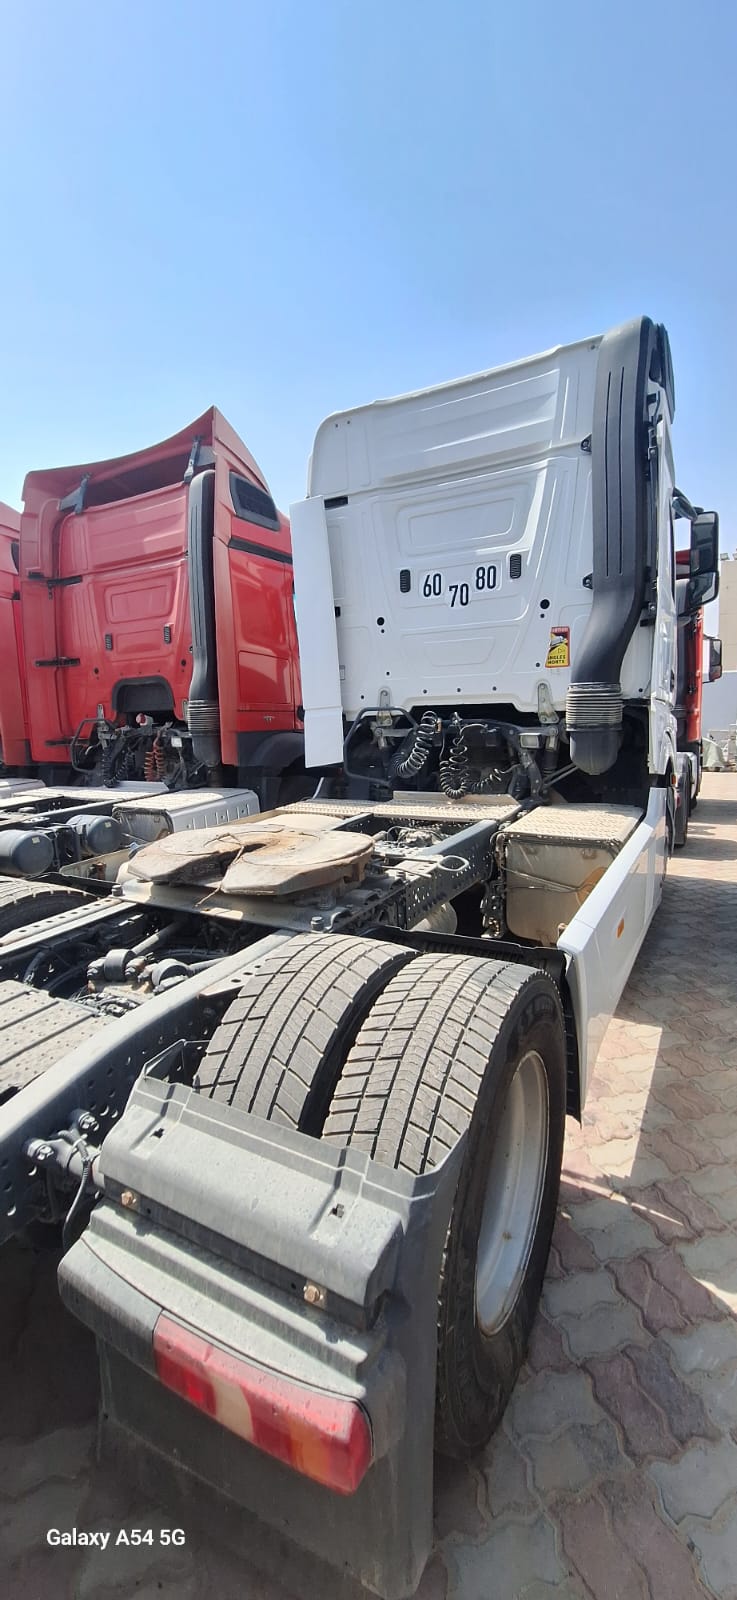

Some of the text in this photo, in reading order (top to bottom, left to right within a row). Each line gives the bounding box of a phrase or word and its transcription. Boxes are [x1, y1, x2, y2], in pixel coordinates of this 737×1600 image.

[423, 573, 442, 598] 60
[475, 565, 497, 590] 80
[448, 583, 469, 607] 70
